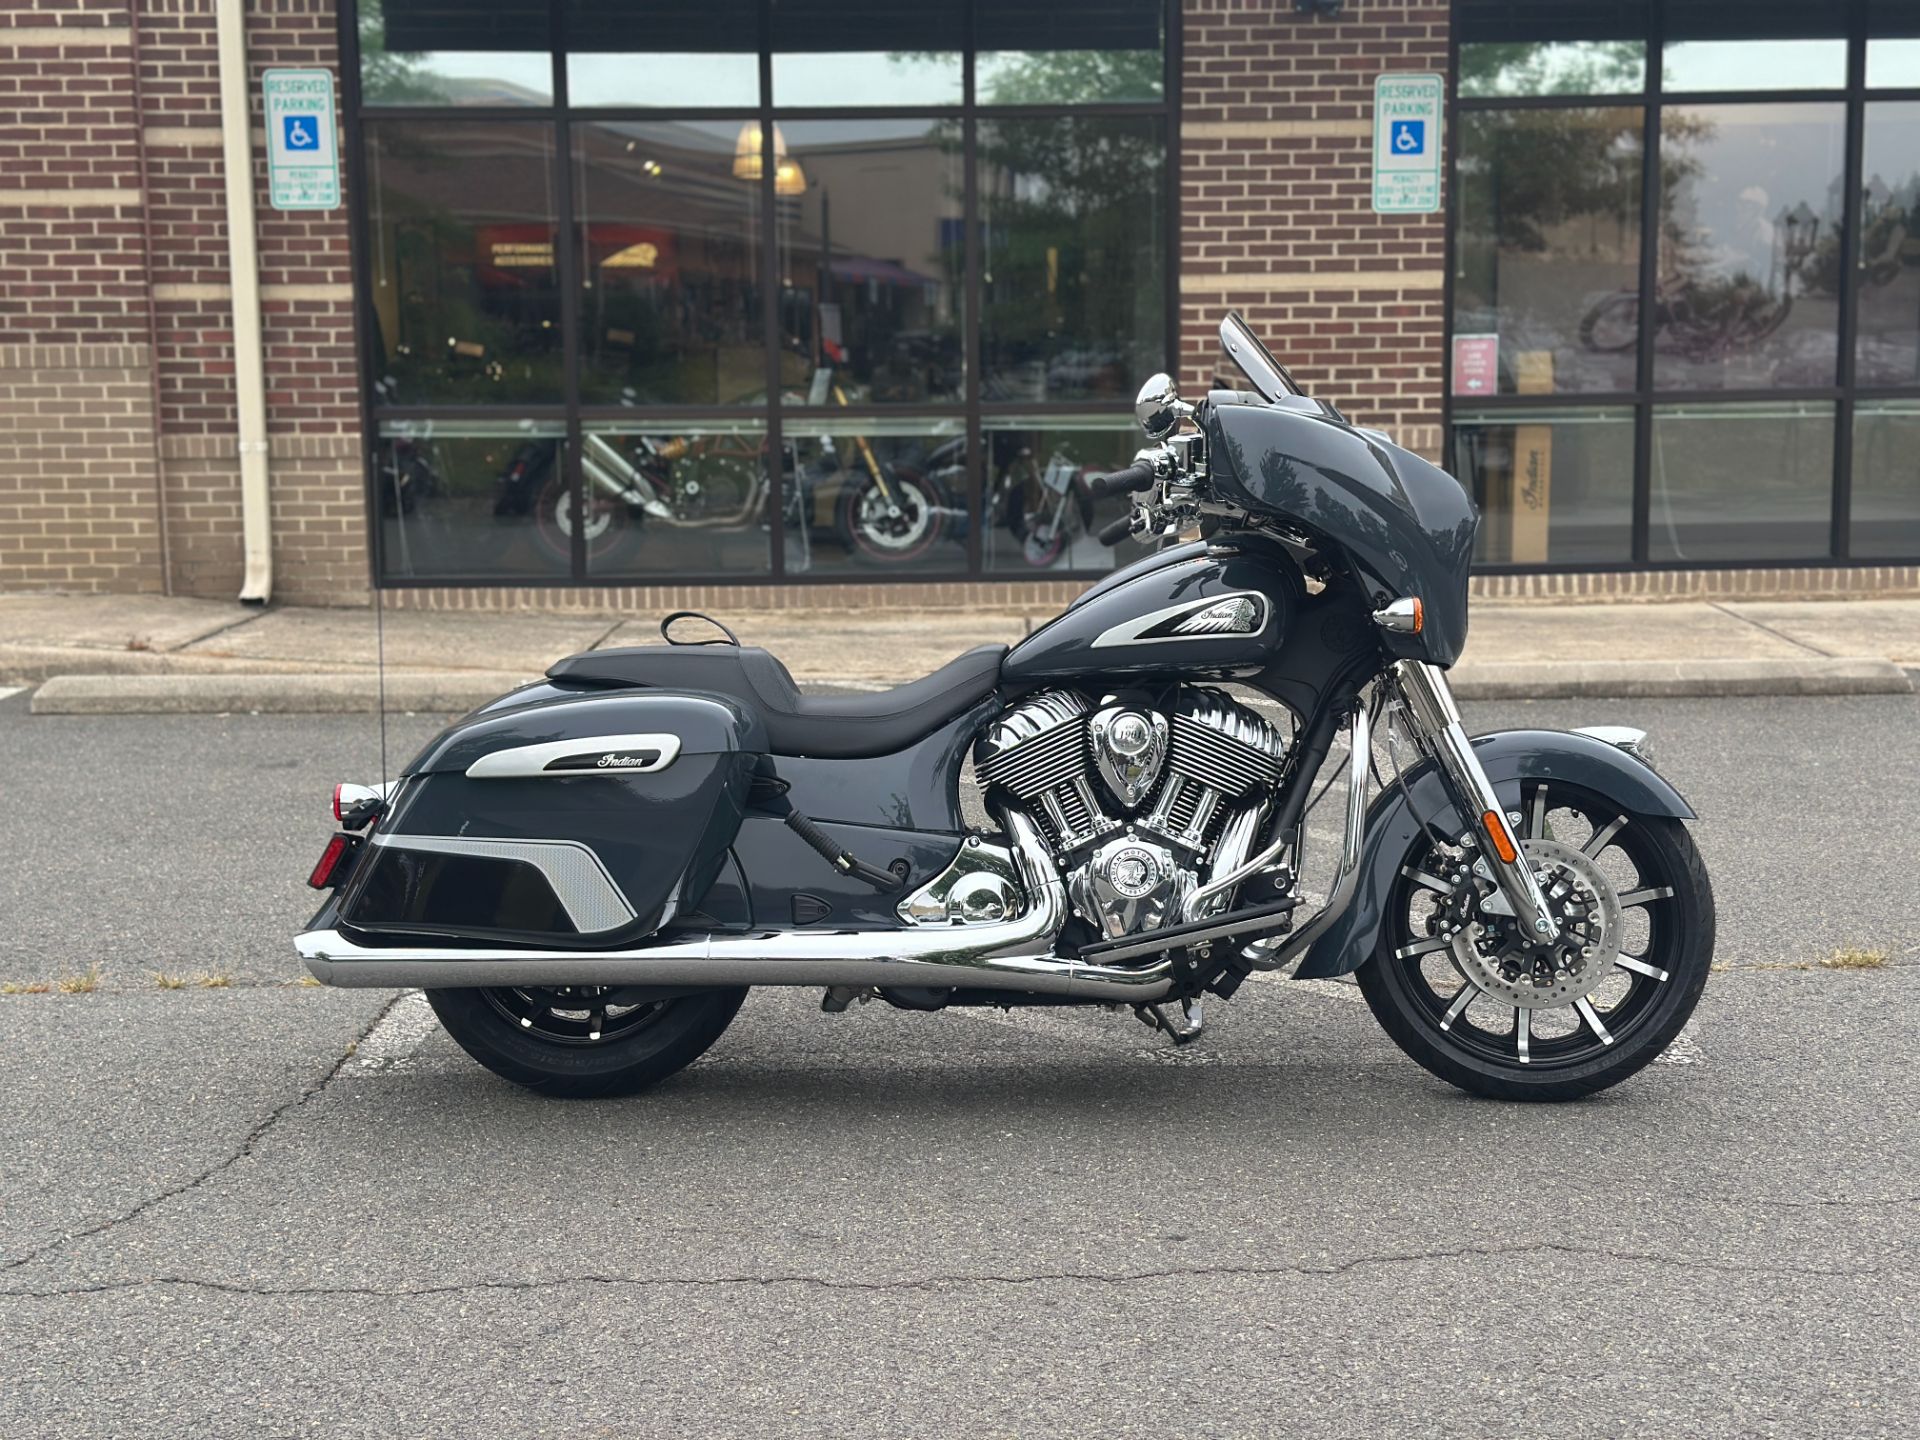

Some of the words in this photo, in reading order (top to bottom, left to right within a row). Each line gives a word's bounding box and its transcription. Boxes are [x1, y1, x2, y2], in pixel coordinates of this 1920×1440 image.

[266, 79, 328, 94] RESERVED
[1380, 84, 1438, 98] RESERVED
[273, 97, 325, 112] PARKING
[1384, 102, 1432, 116] PARKING
[1521, 448, 1538, 511] Indian
[1200, 610, 1233, 620] Indian
[1120, 730, 1142, 739] 1901
[597, 753, 643, 767] Indian
[1111, 855, 1122, 886] INDIAN
[1123, 850, 1156, 886] MOTORCYCLE
